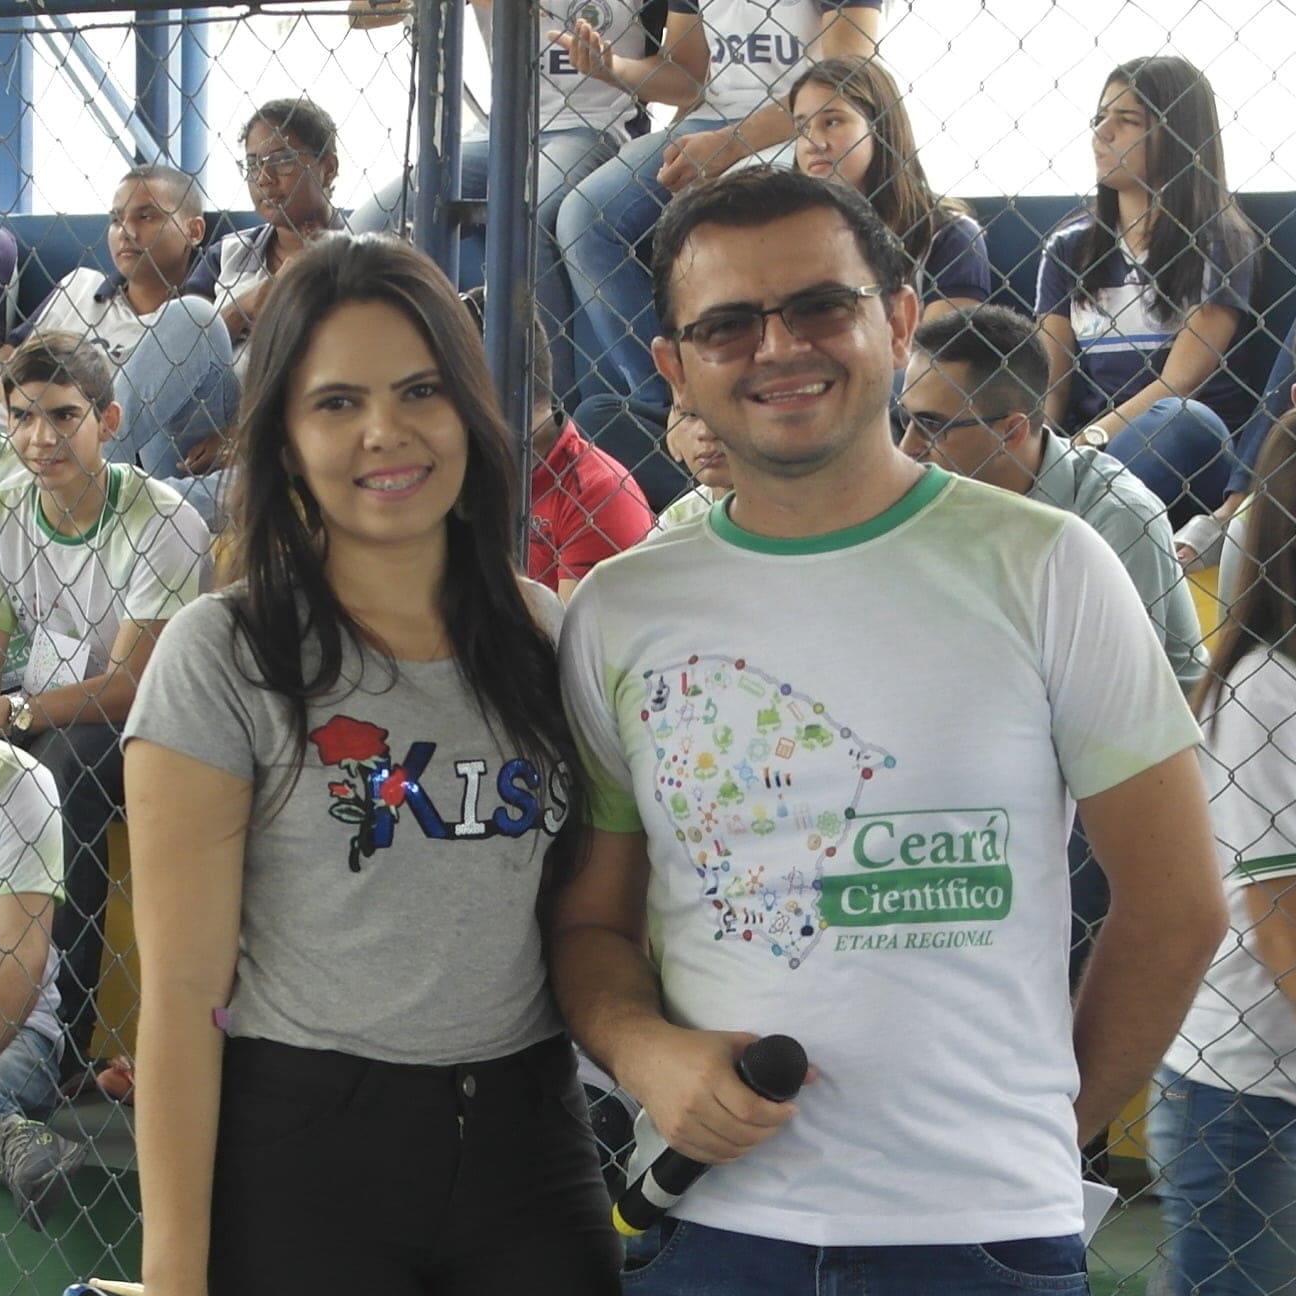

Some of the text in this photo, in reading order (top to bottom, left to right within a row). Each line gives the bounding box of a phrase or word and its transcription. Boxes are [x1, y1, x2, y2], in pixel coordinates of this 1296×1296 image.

[711, 34, 799, 65] ICEU
[364, 740, 574, 849] KISS
[853, 815, 1002, 869] Ceará
[840, 877, 1004, 916] Científico
[834, 930, 994, 951] ETAPA REGIONAL
